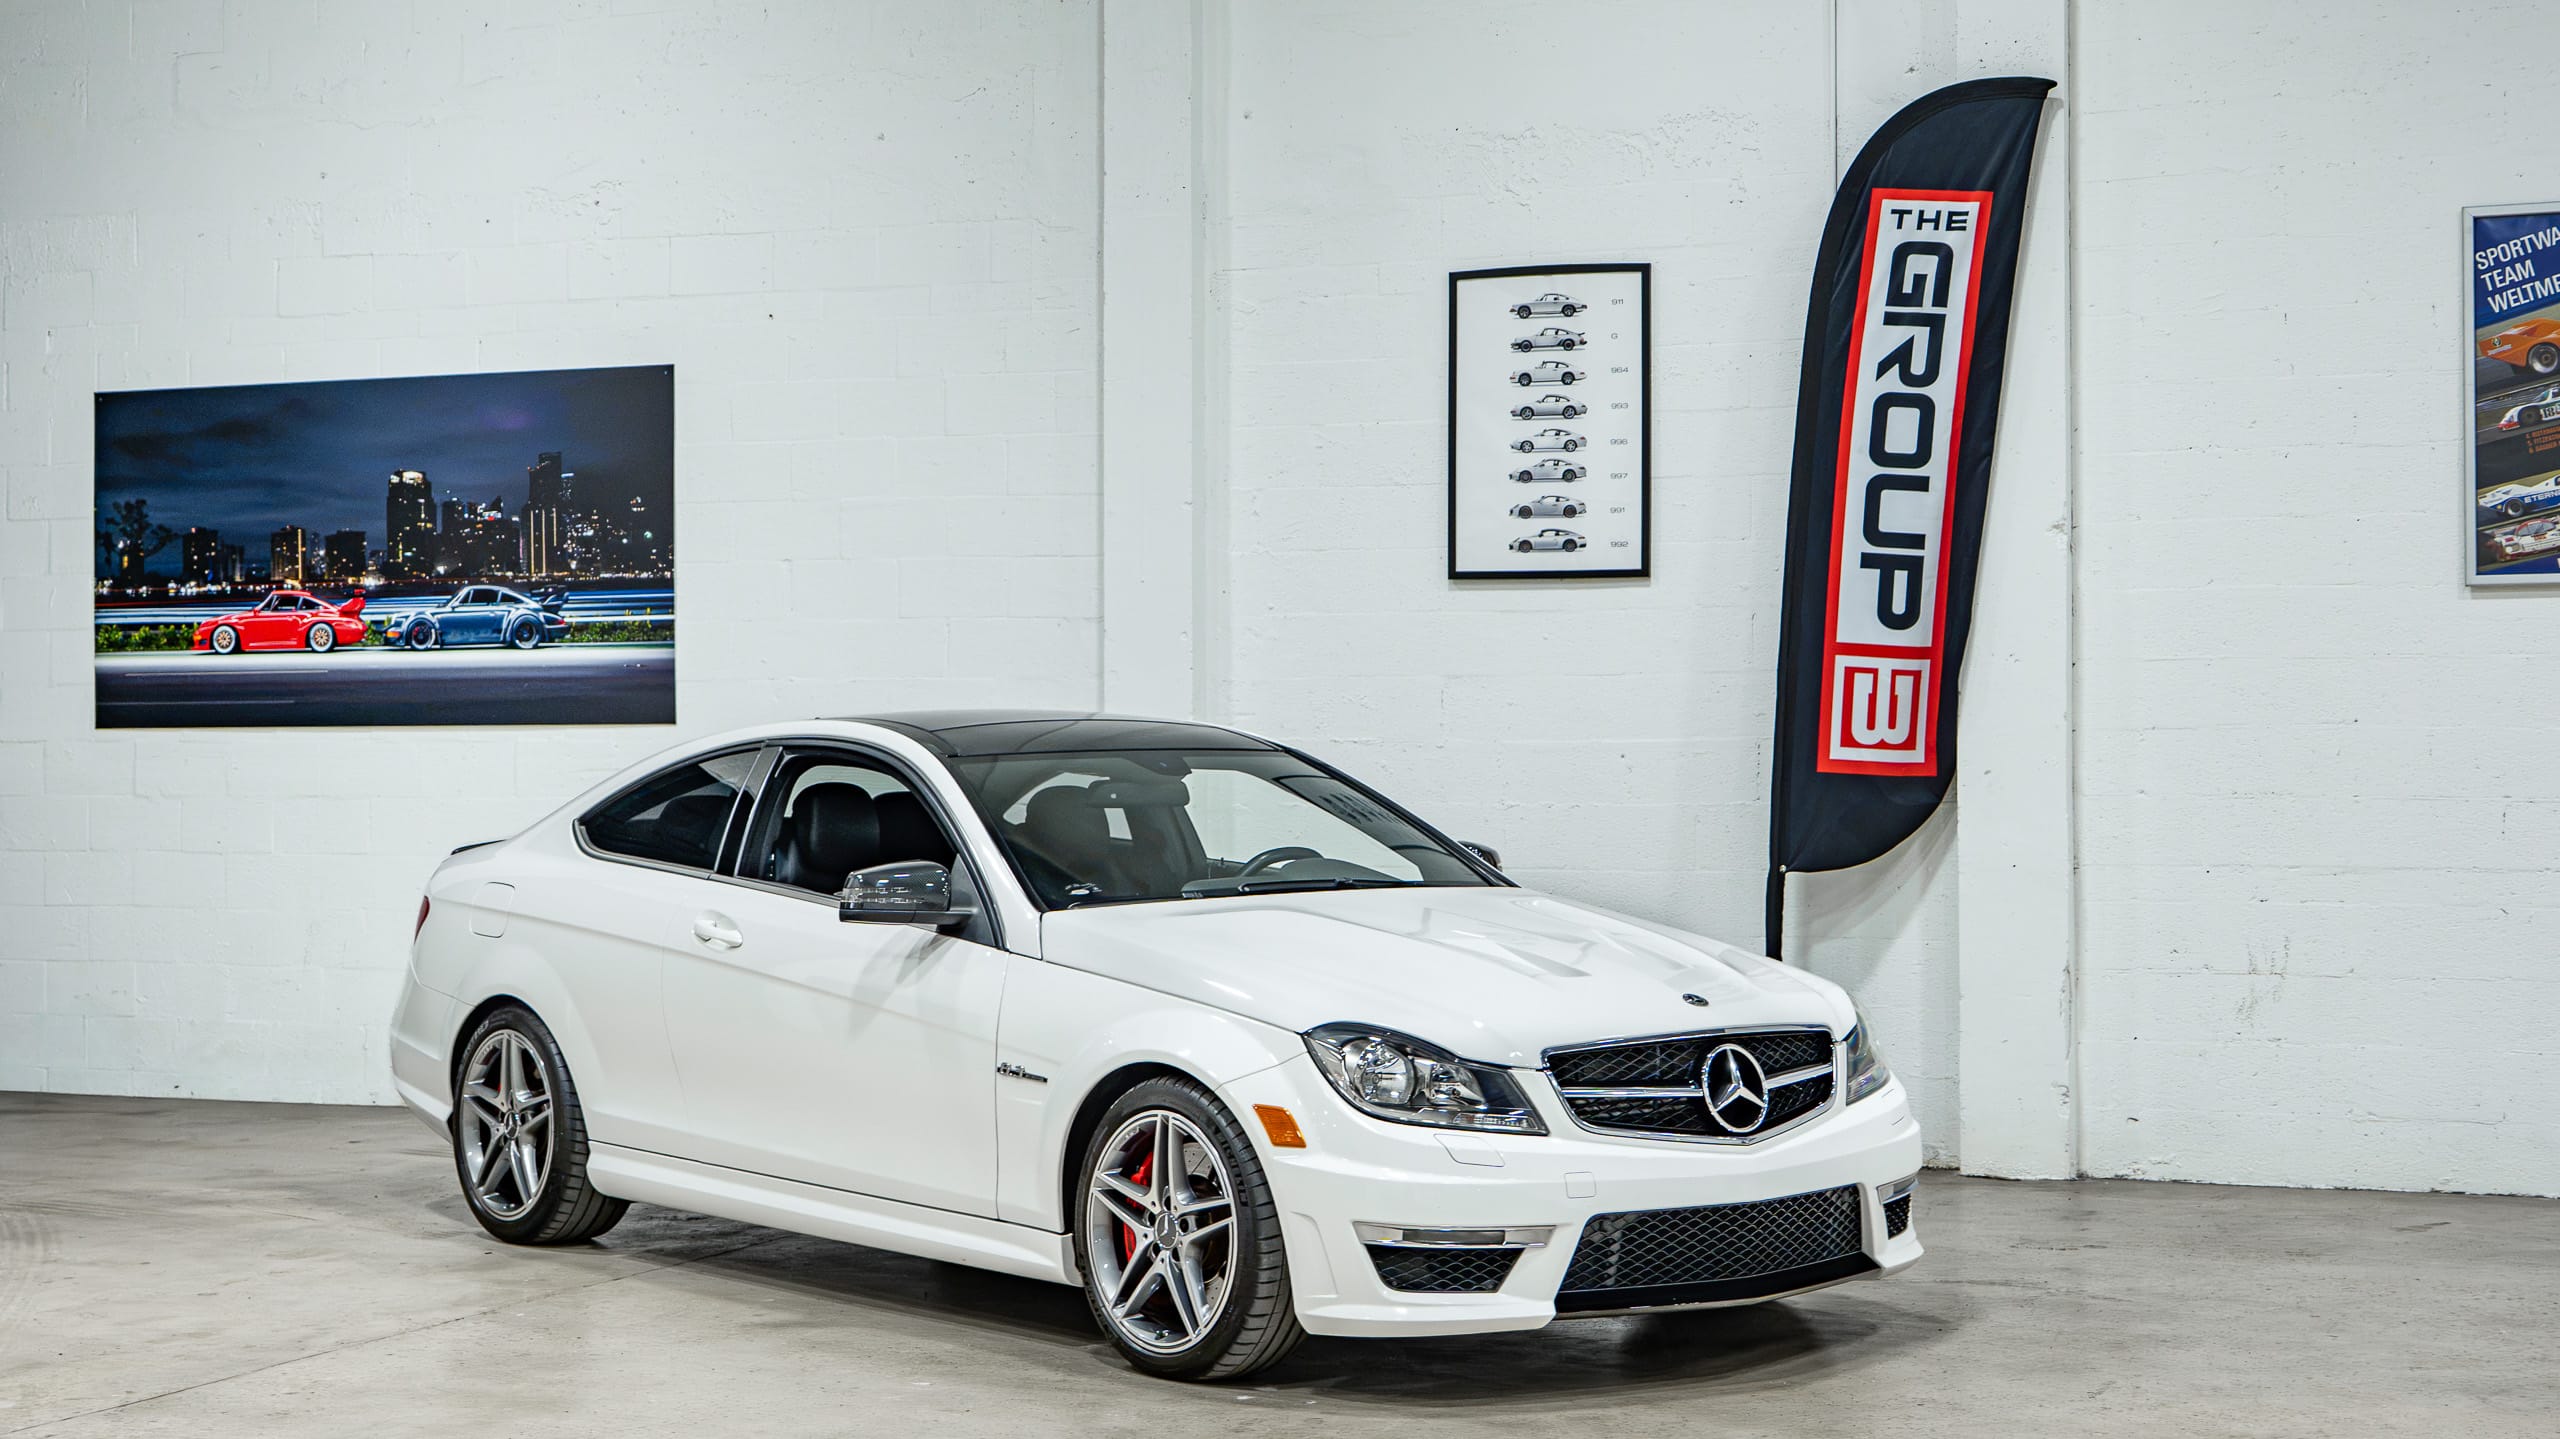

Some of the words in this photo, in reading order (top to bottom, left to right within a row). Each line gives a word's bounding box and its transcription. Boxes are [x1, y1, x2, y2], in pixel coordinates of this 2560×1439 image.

[1890, 209, 1970, 231] THE
[2480, 259, 2536, 291] TEAM
[1611, 298, 1624, 306] 911
[1859, 241, 1954, 631] GROUP
